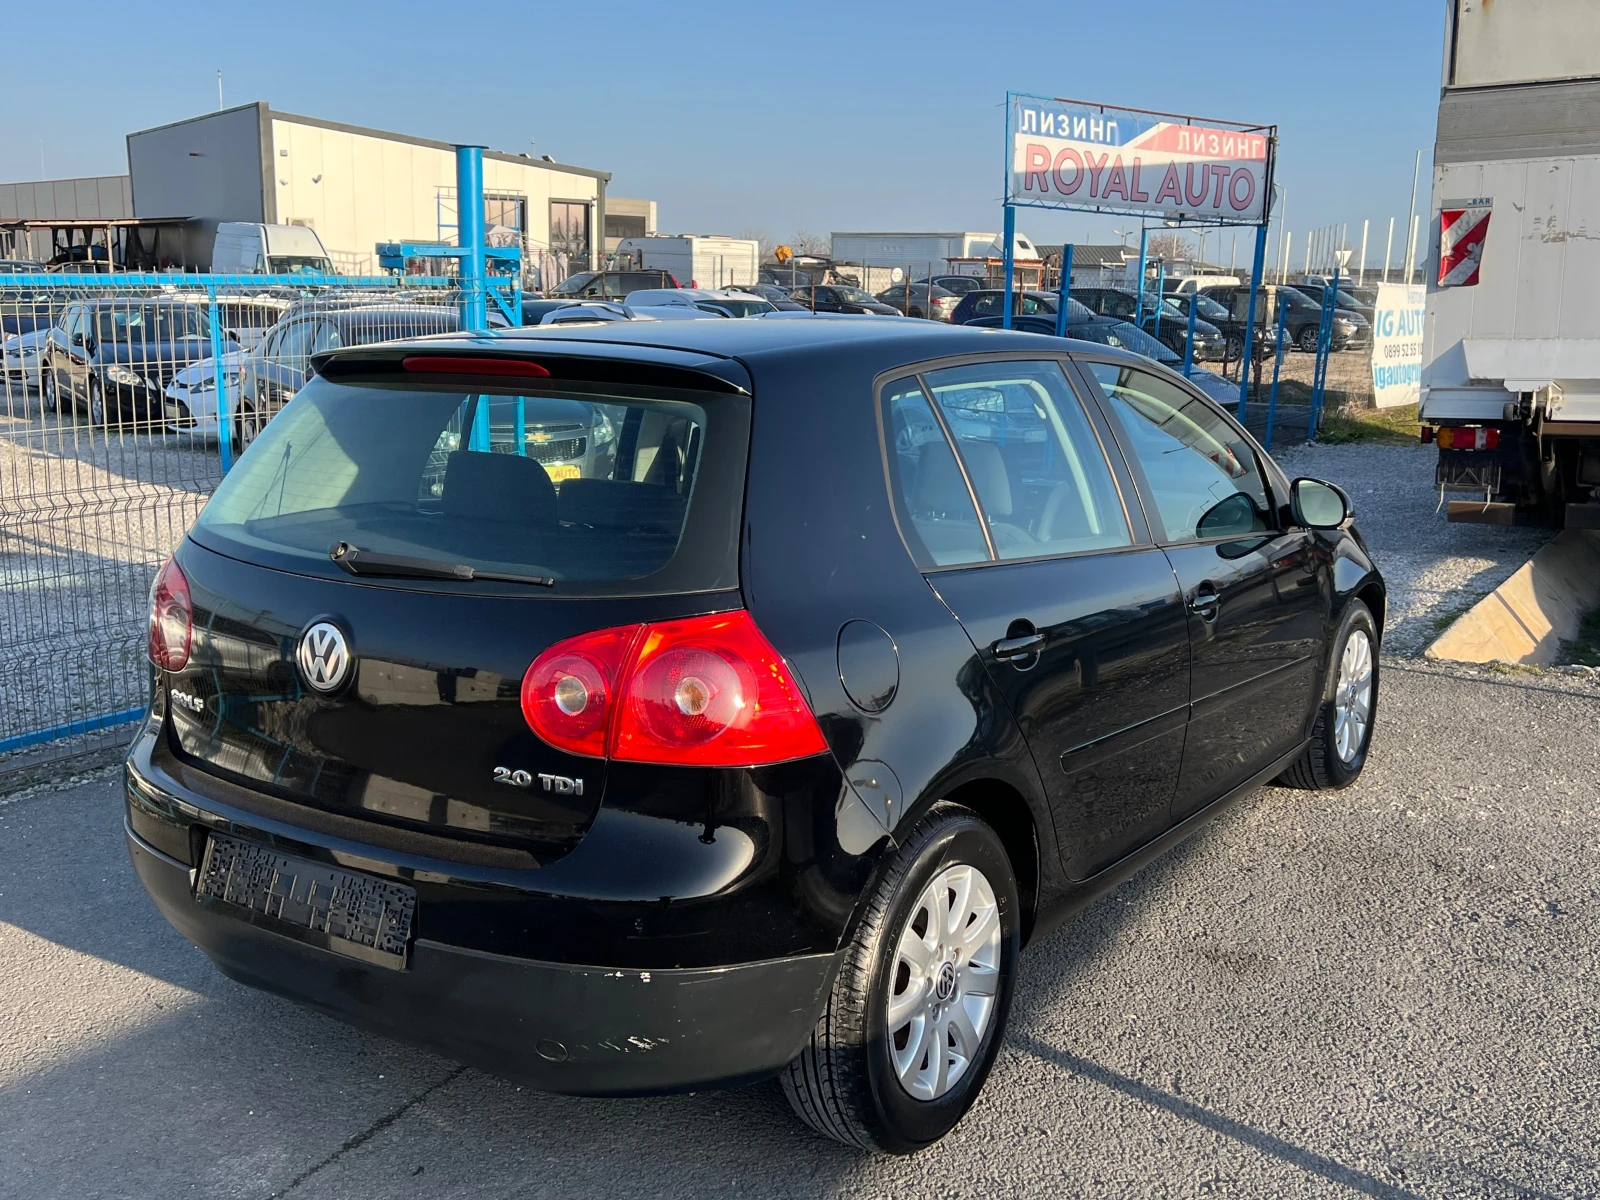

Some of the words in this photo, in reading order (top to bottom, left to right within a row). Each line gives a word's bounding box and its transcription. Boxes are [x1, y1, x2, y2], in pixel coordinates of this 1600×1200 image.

[1022, 109, 1117, 142] ЛИЗИНГ
[1177, 131, 1261, 158] ЛИЗИНГ
[1025, 143, 1149, 202] ROYAL
[1155, 159, 1255, 211] AUTO
[1376, 309, 1394, 337] IG
[1384, 344, 1400, 359] 0899
[1401, 343, 1409, 357] 52
[555, 469, 580, 479] AUTO
[537, 773, 584, 796] TDI
